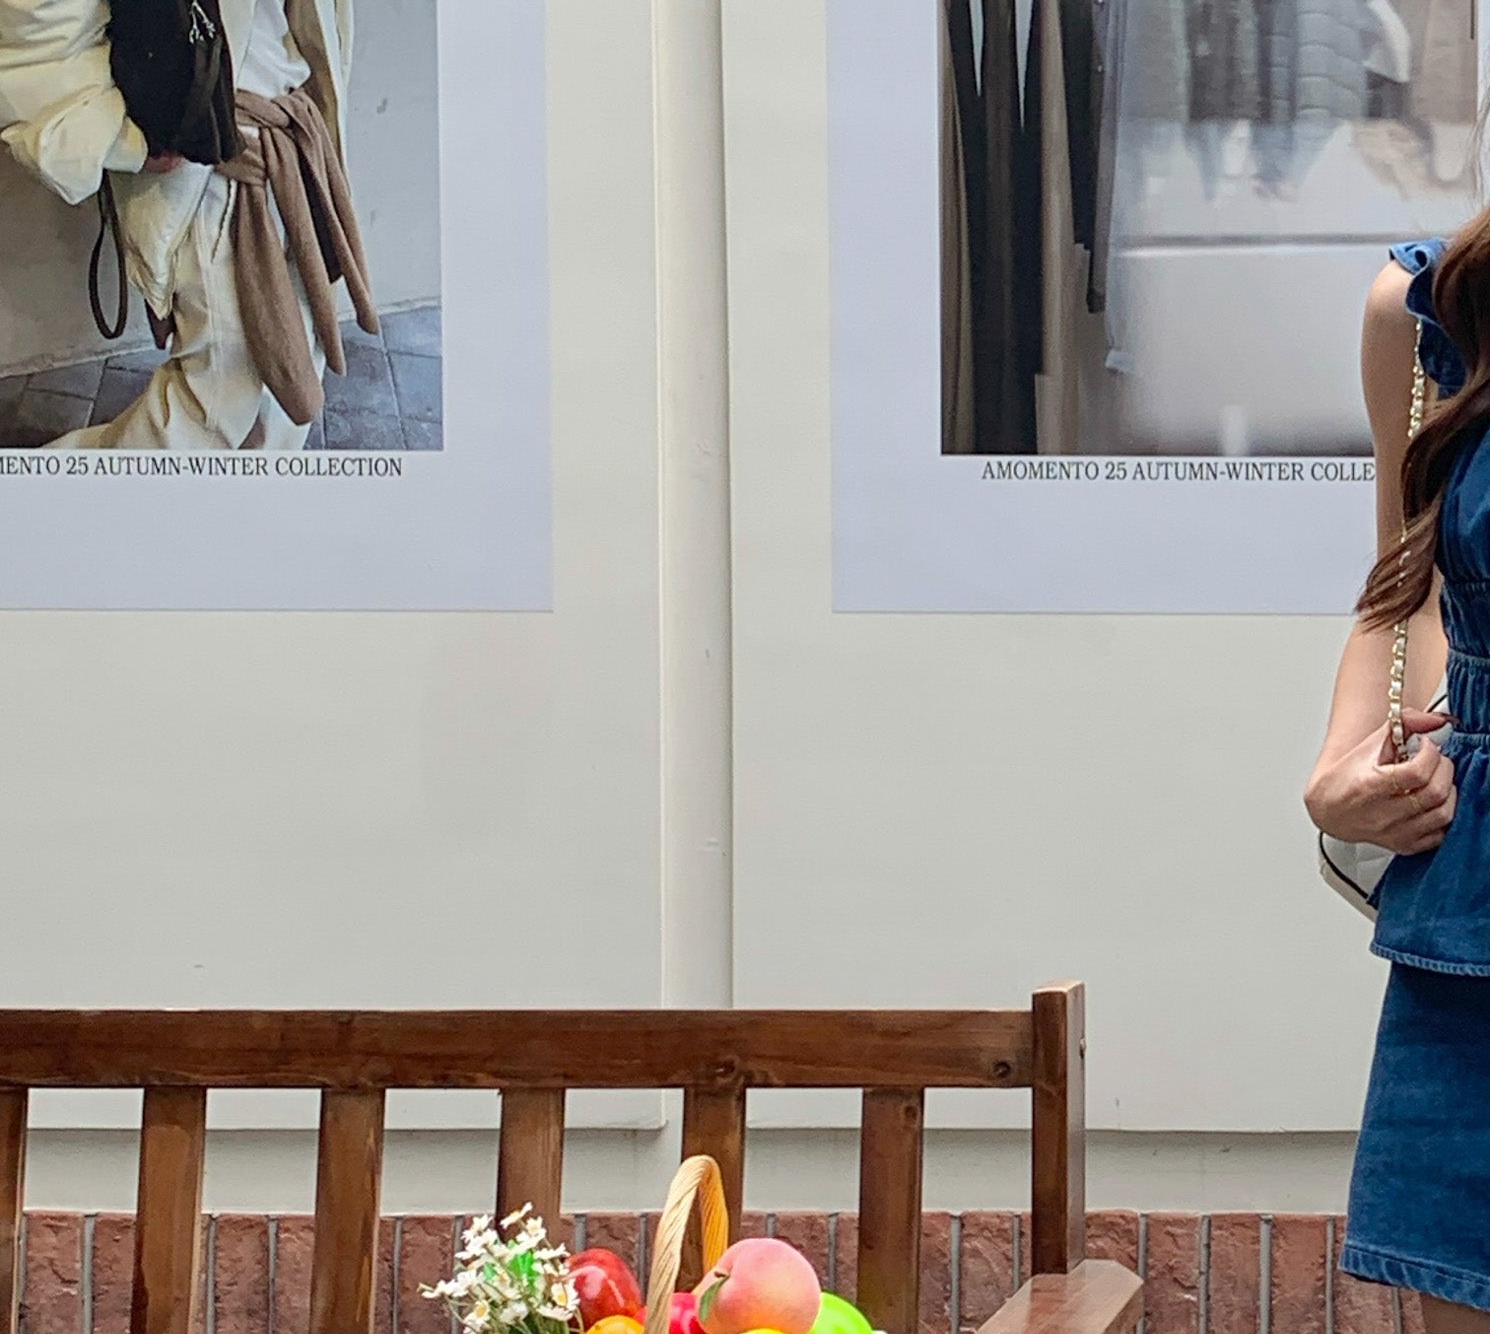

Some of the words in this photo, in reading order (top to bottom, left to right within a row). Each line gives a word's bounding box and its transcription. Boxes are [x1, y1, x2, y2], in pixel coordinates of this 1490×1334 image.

[66, 455, 89, 476] 25
[94, 455, 269, 477] AUTUMN-WINTER
[275, 456, 403, 478] COLLECTION
[981, 460, 1100, 481] AMOMENTO
[1105, 460, 1128, 481] 25
[1132, 460, 1305, 482] AUTUMN-WINTER
